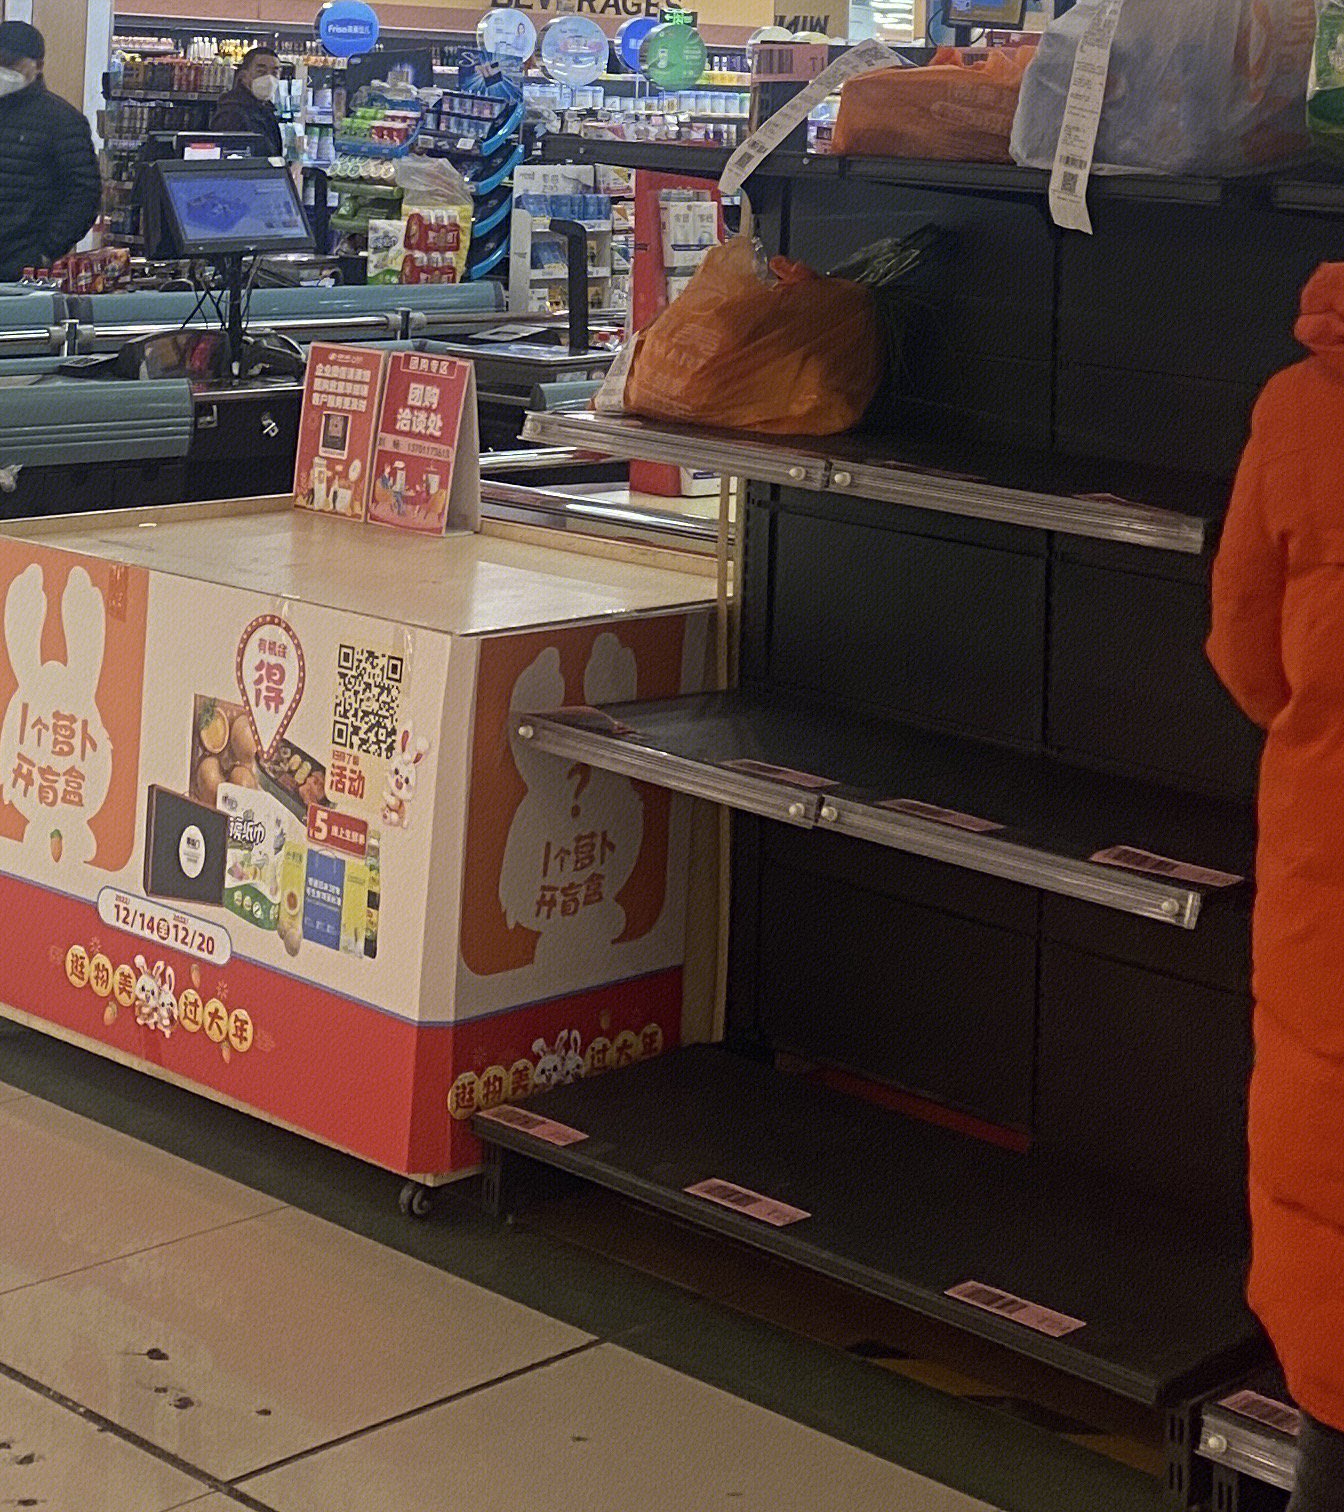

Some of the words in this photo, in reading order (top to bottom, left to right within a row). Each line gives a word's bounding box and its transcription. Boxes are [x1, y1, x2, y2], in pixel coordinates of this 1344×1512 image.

[396, 408, 443, 437] 洽谈处
[12, 752, 86, 807] 开盲盒
[330, 764, 365, 799] 活动
[535, 872, 605, 919] 开盲盒
[69, 952, 134, 999] 逛物美
[182, 996, 250, 1046] 过大年
[455, 1063, 532, 1110] 逛物美
